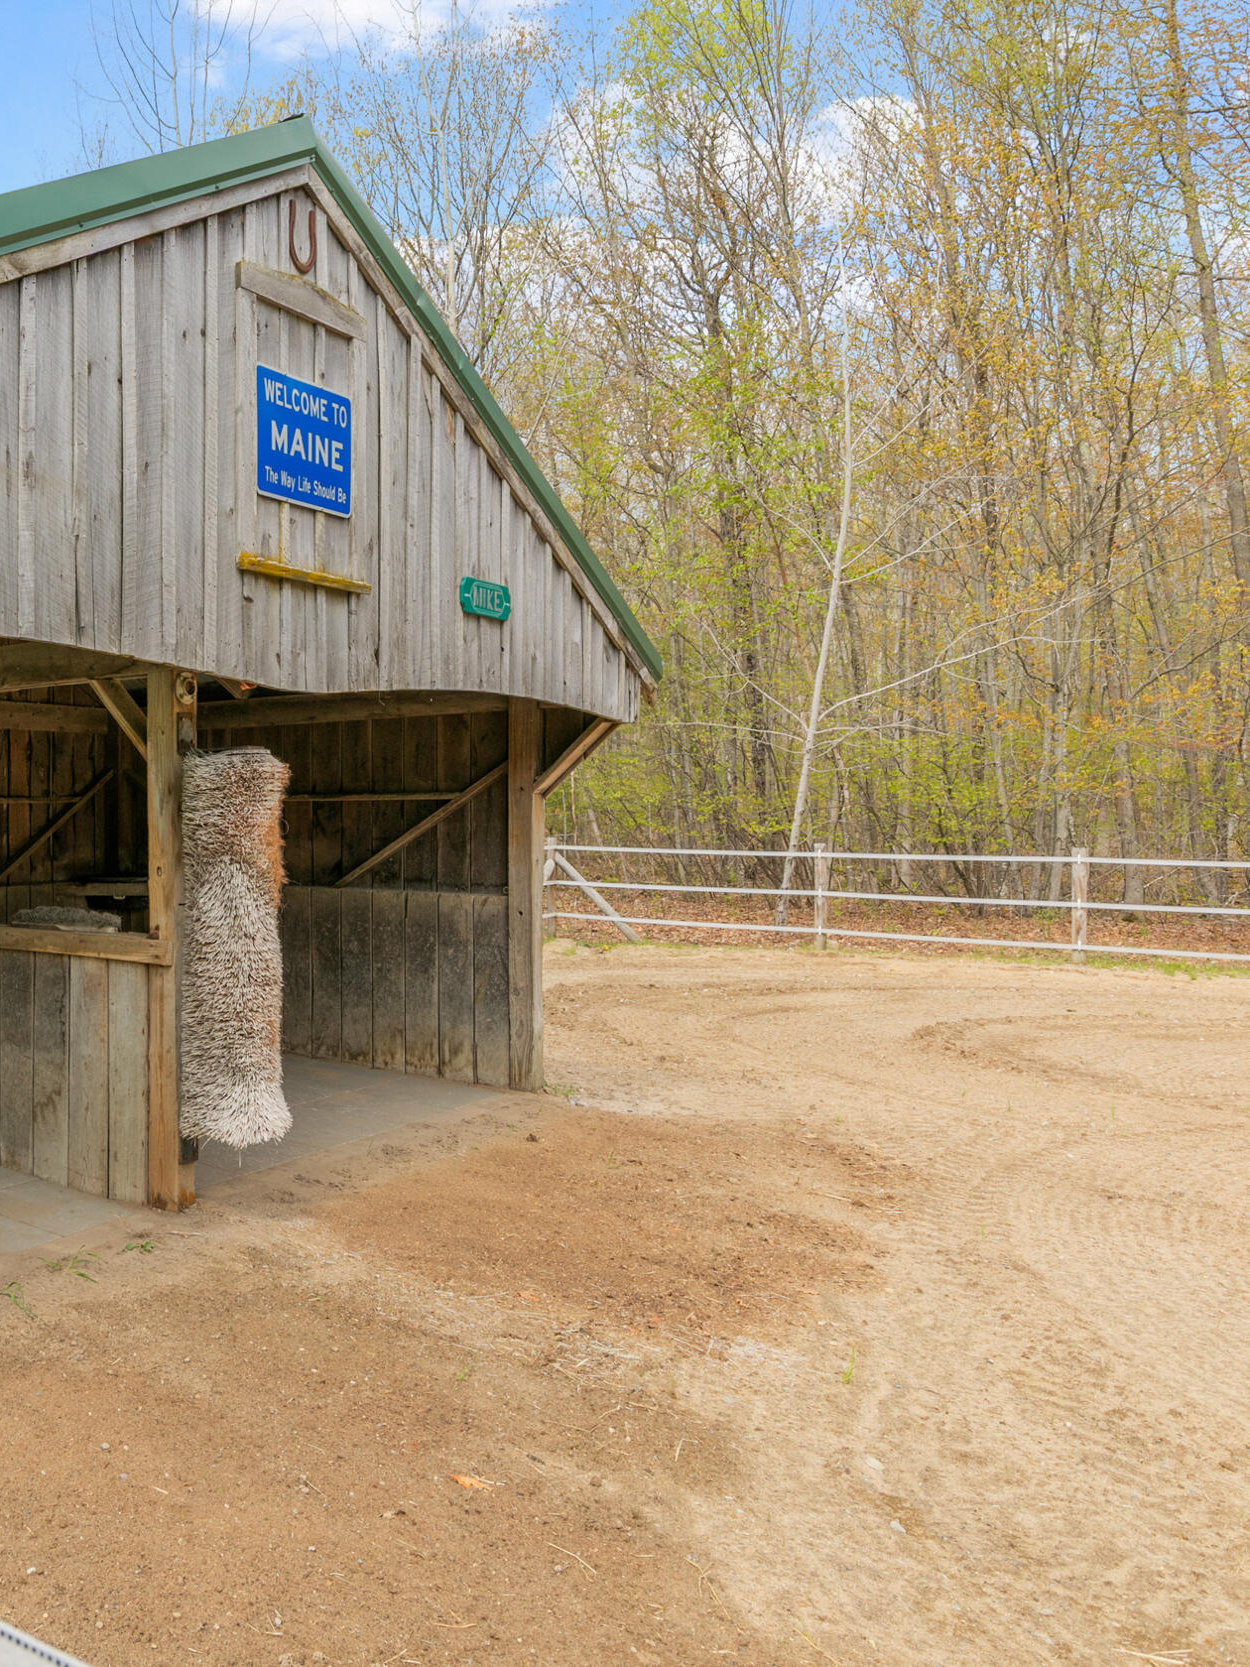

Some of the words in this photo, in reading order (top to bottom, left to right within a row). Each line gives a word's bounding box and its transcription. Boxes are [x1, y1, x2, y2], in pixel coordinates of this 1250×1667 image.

[264, 377, 329, 423] WELCOME
[331, 402, 348, 428] TO
[271, 419, 344, 472] MAINE
[265, 465, 279, 484] The
[281, 470, 296, 492] Way
[298, 476, 311, 494] Life
[313, 480, 336, 501] Should
[338, 487, 347, 504] Be
